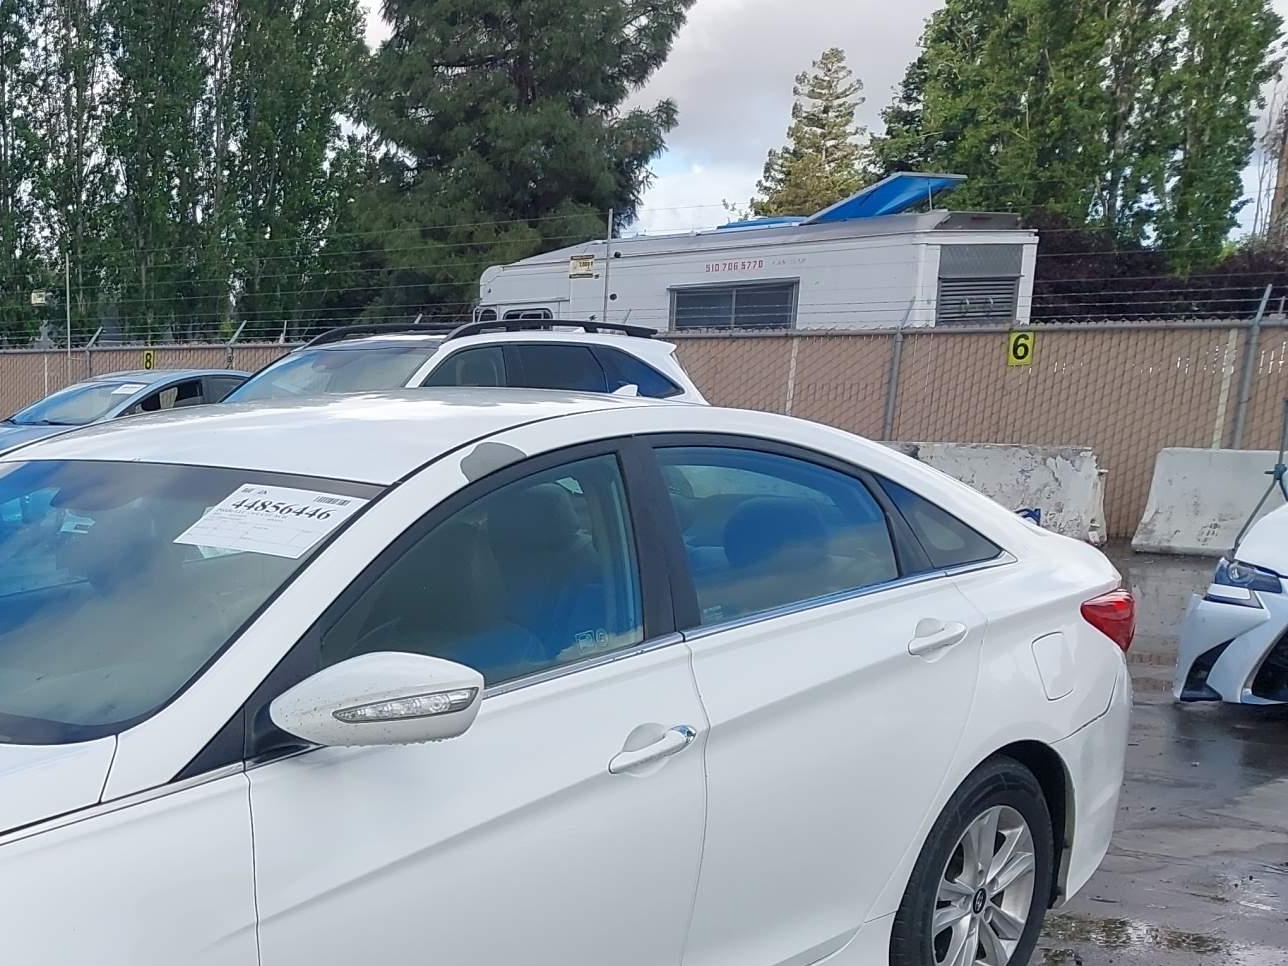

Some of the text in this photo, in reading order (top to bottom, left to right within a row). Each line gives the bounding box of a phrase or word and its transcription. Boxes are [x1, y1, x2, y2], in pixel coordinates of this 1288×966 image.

[705, 263, 720, 273] 510
[722, 261, 738, 271] 706
[741, 259, 764, 270] 5770
[1012, 333, 1030, 361] 6
[144, 352, 153, 370] 8
[231, 496, 338, 521] 44856446
